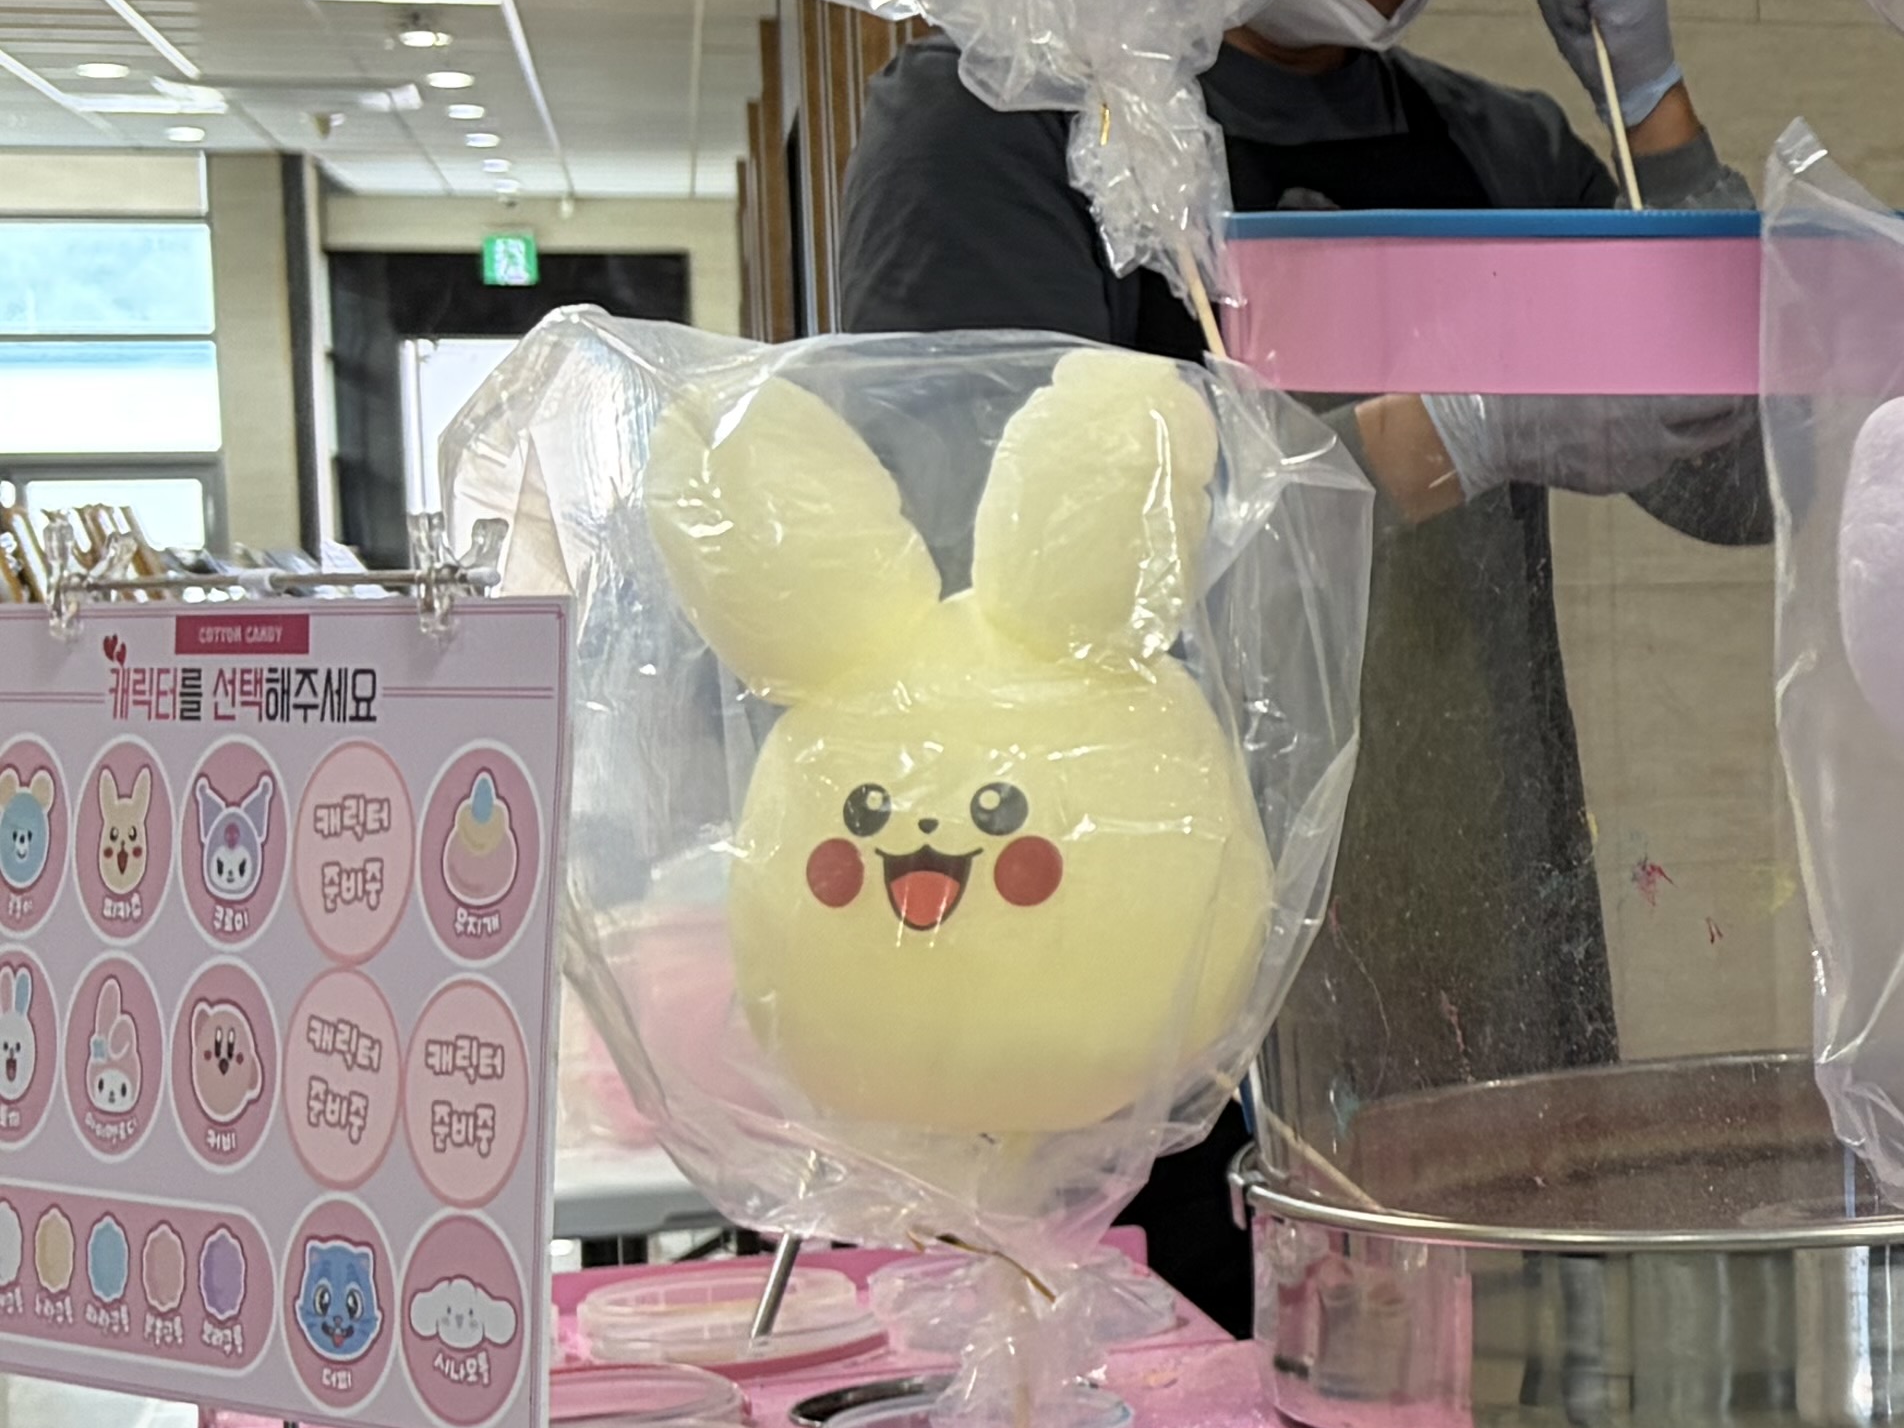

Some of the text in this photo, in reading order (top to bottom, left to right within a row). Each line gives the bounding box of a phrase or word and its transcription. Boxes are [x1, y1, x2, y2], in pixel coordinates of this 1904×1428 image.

[199, 625, 283, 644] COTTON CANDY
[109, 667, 377, 723] 캐릭터를 선택해주세요
[314, 794, 391, 842] 캐릭터
[322, 858, 384, 913] 준비중
[455, 907, 500, 936] 무지개
[307, 1014, 382, 1072] 캐릭터
[425, 1034, 504, 1085] 캐릭터
[307, 1076, 369, 1144] 준비중
[432, 1100, 495, 1158] 준비중
